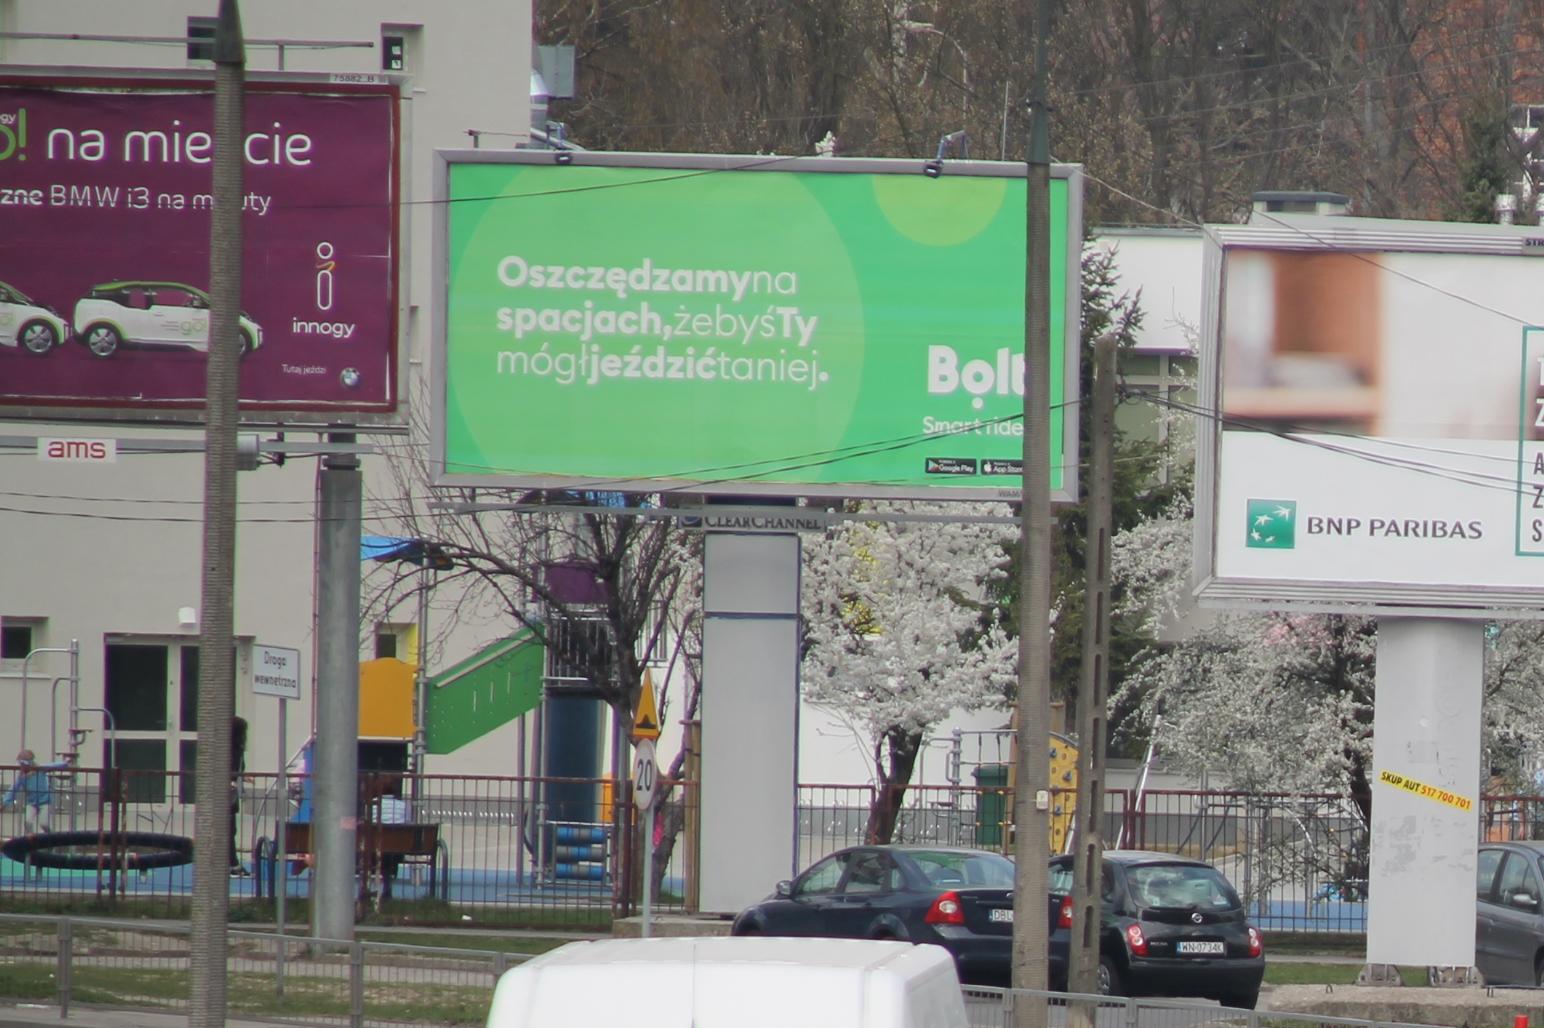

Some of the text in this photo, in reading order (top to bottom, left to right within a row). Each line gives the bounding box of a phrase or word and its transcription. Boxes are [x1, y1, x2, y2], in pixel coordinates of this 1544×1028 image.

[47, 128, 105, 161] na
[124, 119, 312, 166] miecie
[50, 184, 119, 208] BMW
[127, 186, 150, 209] i3
[157, 192, 185, 210] na
[292, 316, 356, 338] innogy
[922, 415, 982, 435] Smart
[48, 441, 106, 459] ams
[1306, 515, 1484, 540] BNP PARIBAS
[264, 650, 287, 670] Droga
[636, 758, 653, 791] 20
[1381, 771, 1472, 810] SKUP AUT 517 700 701
